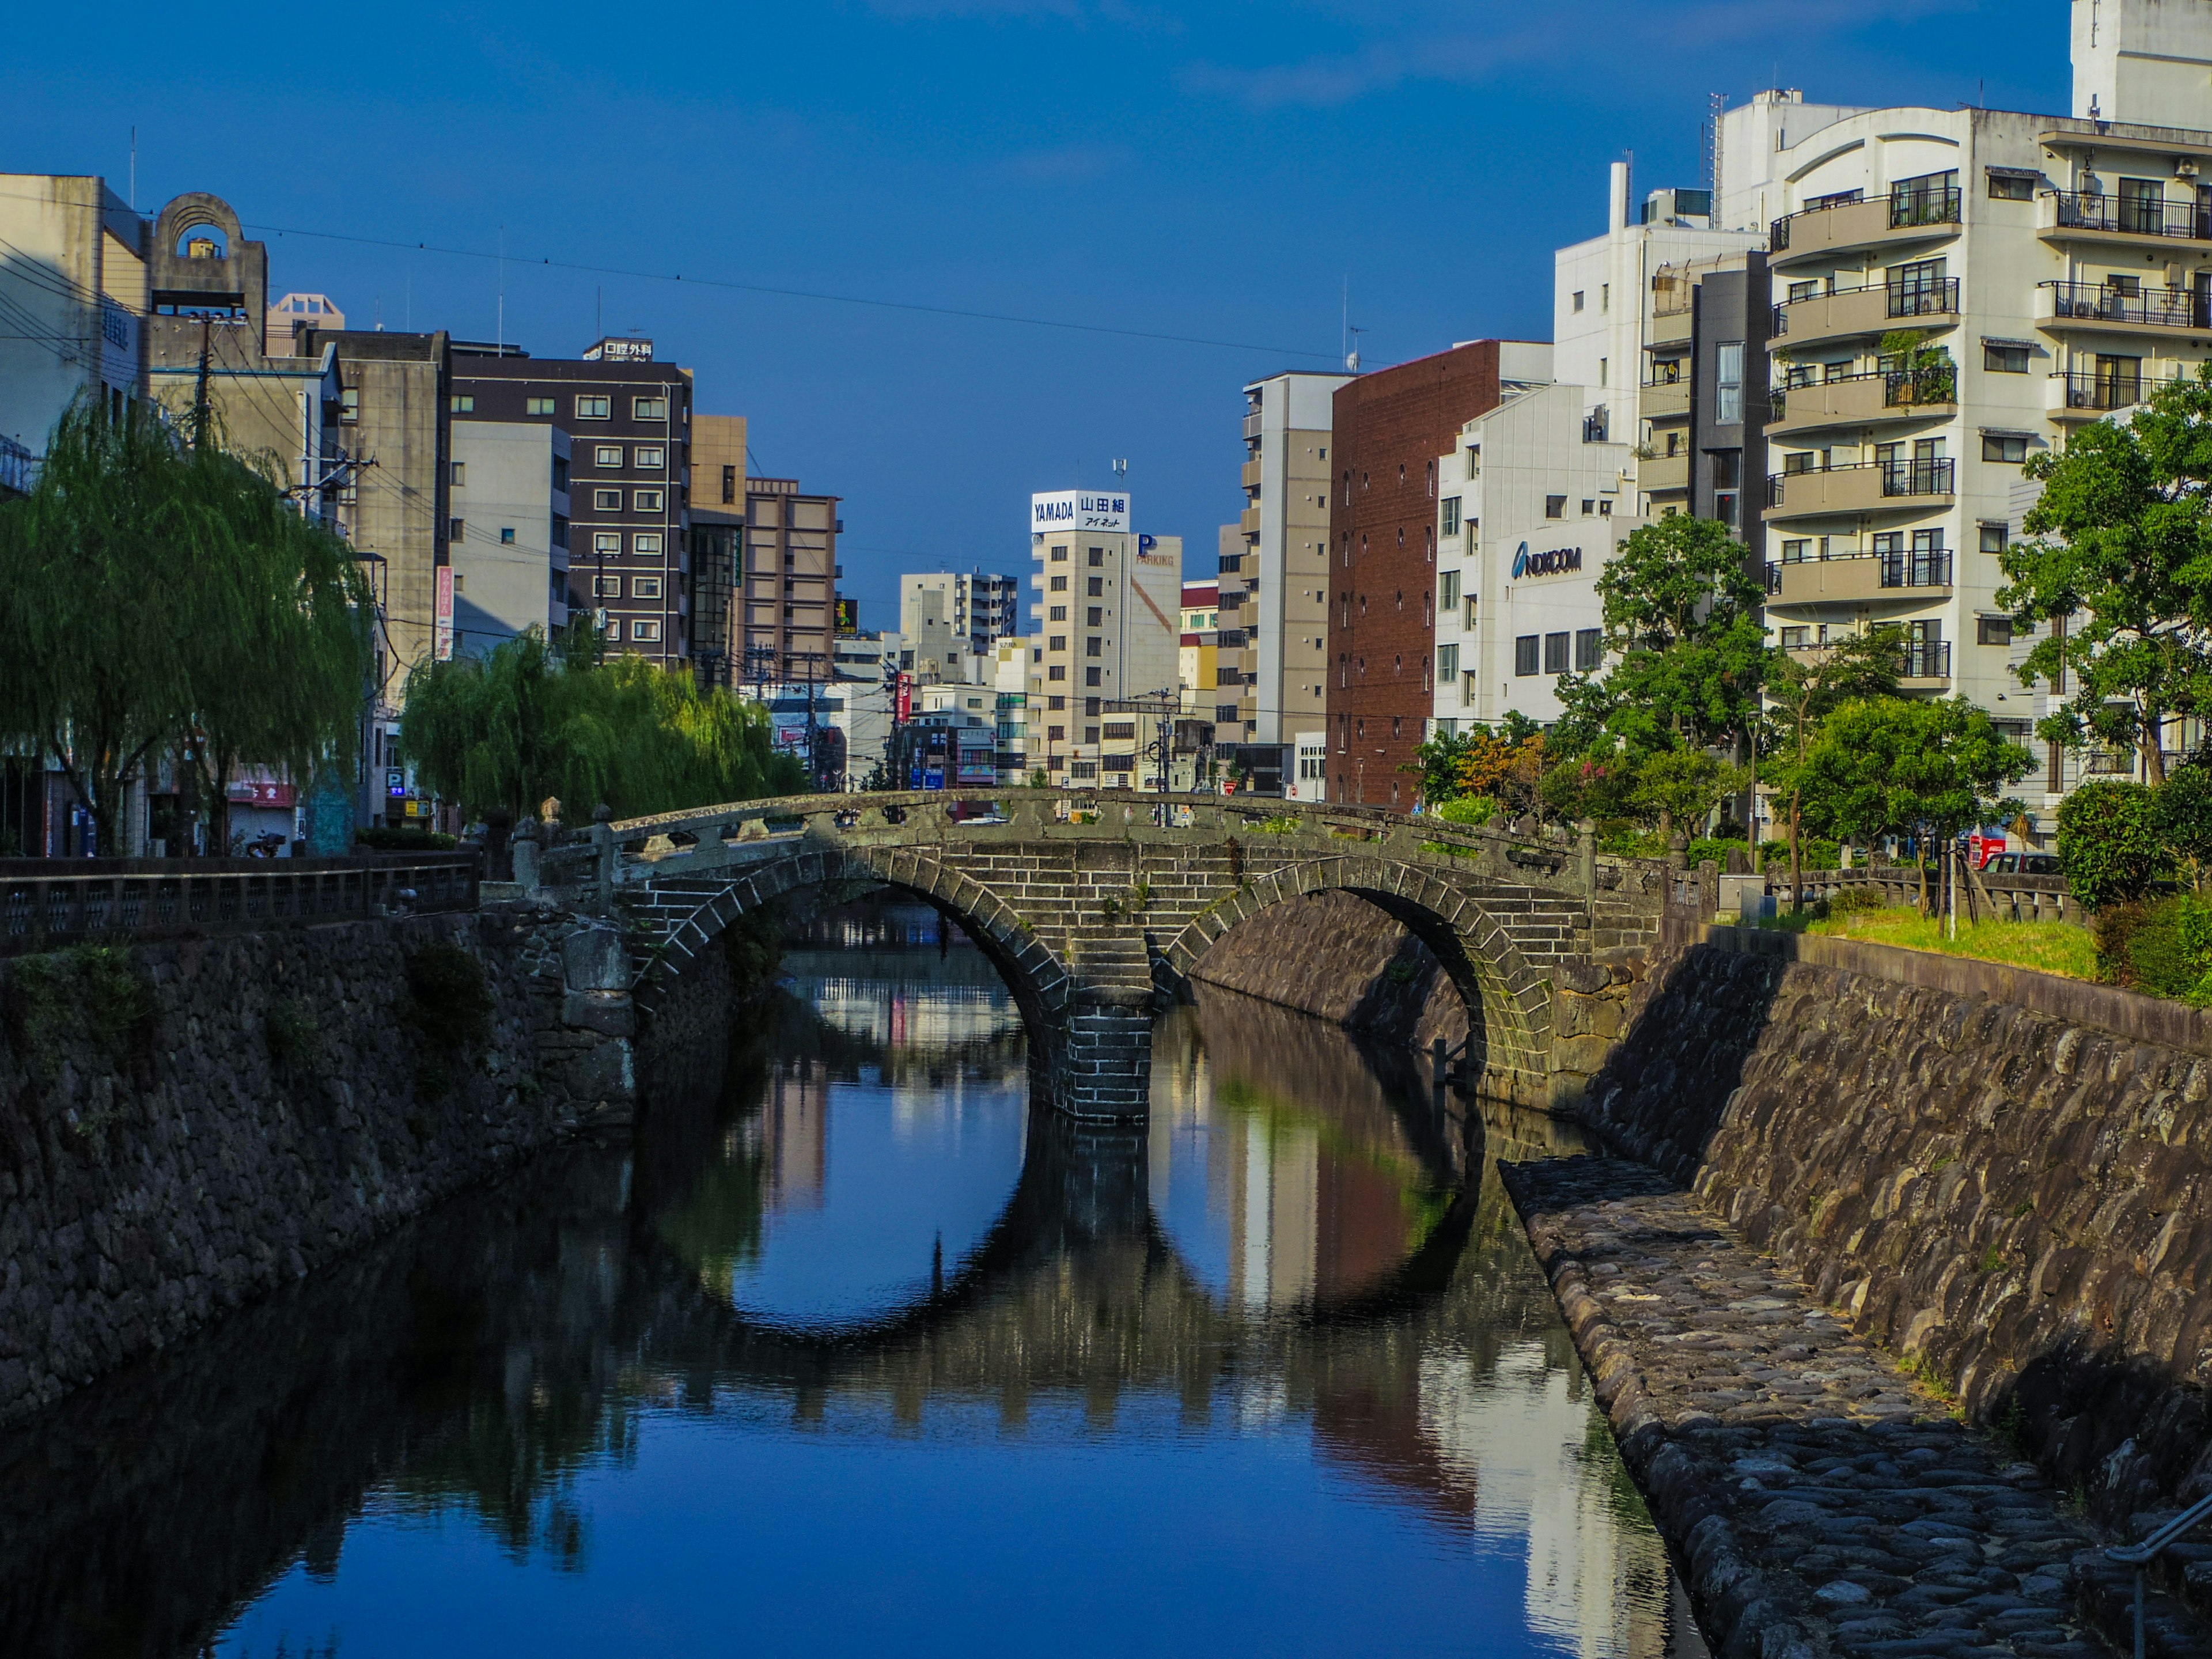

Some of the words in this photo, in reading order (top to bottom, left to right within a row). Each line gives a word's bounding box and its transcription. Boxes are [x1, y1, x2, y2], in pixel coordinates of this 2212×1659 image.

[605, 343, 652, 356] 口腔外科
[1035, 501, 1074, 522] YAMADA
[1081, 497, 1125, 513] 山田組
[1085, 516, 1120, 527] アイネット
[1138, 533, 1154, 555] P
[1137, 555, 1174, 566] PARKING
[388, 774, 402, 787] P
